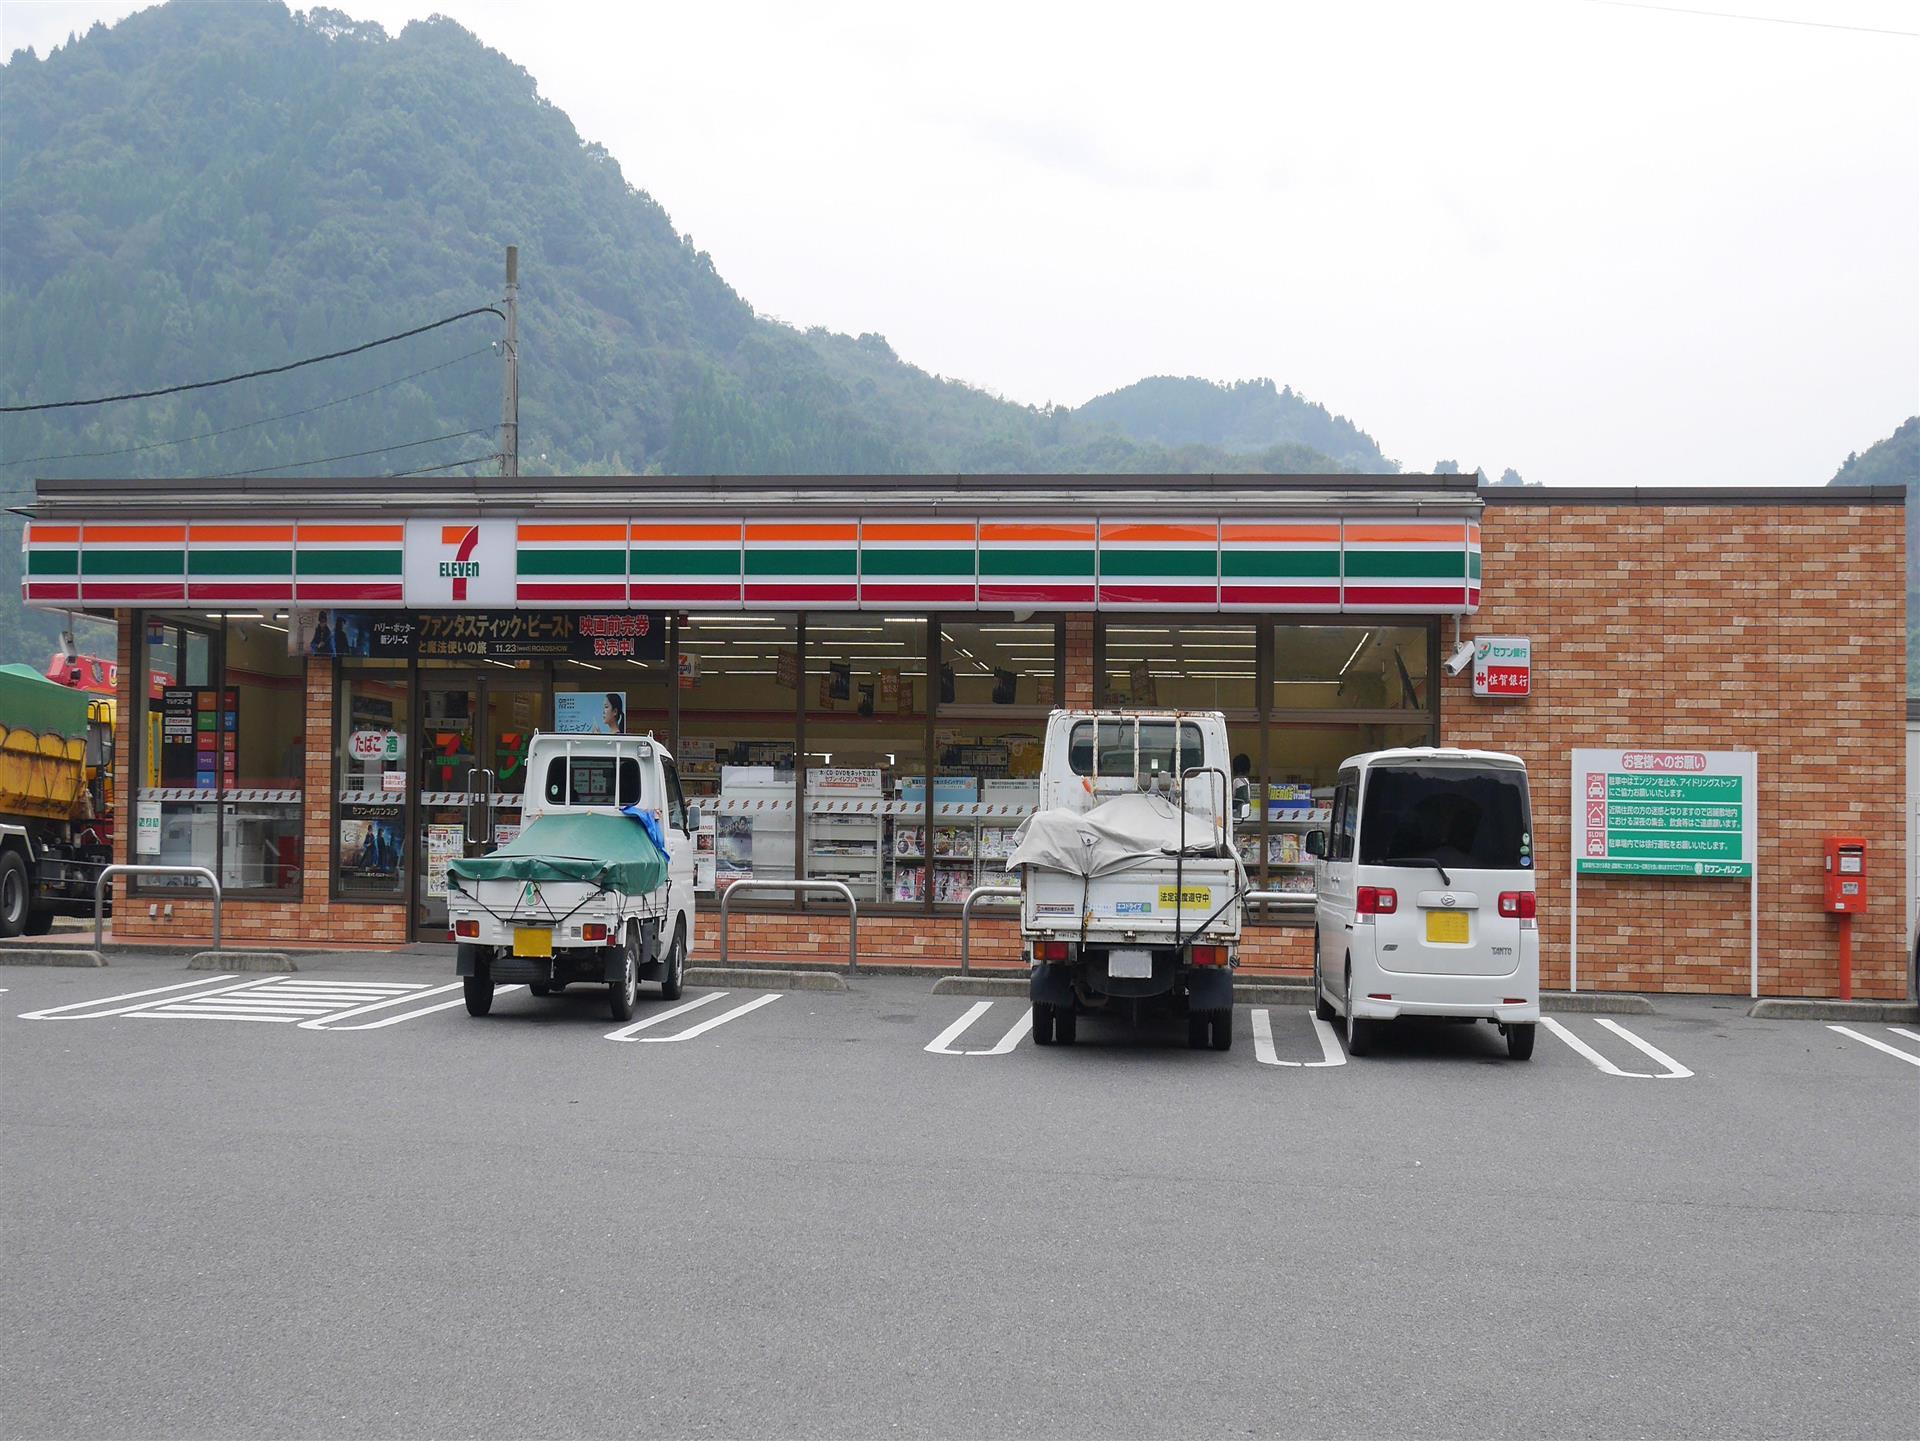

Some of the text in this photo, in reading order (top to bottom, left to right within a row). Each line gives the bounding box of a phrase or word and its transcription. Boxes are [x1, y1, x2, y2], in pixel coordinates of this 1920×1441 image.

[374, 623, 416, 632] ハリー・ポッター
[418, 615, 574, 638] ファンタスティック・ビースト
[579, 615, 649, 636] 映画前売券
[380, 634, 409, 645] 新シリーズ
[418, 641, 487, 655] と魔法使いの旅
[1493, 647, 1527, 658] セブン銀行
[1488, 673, 1528, 687] 佐賀銀行
[355, 735, 398, 753] たばこ 酒
[1622, 753, 1706, 770] お客様へのお願い
[1491, 946, 1512, 955] TANTO
